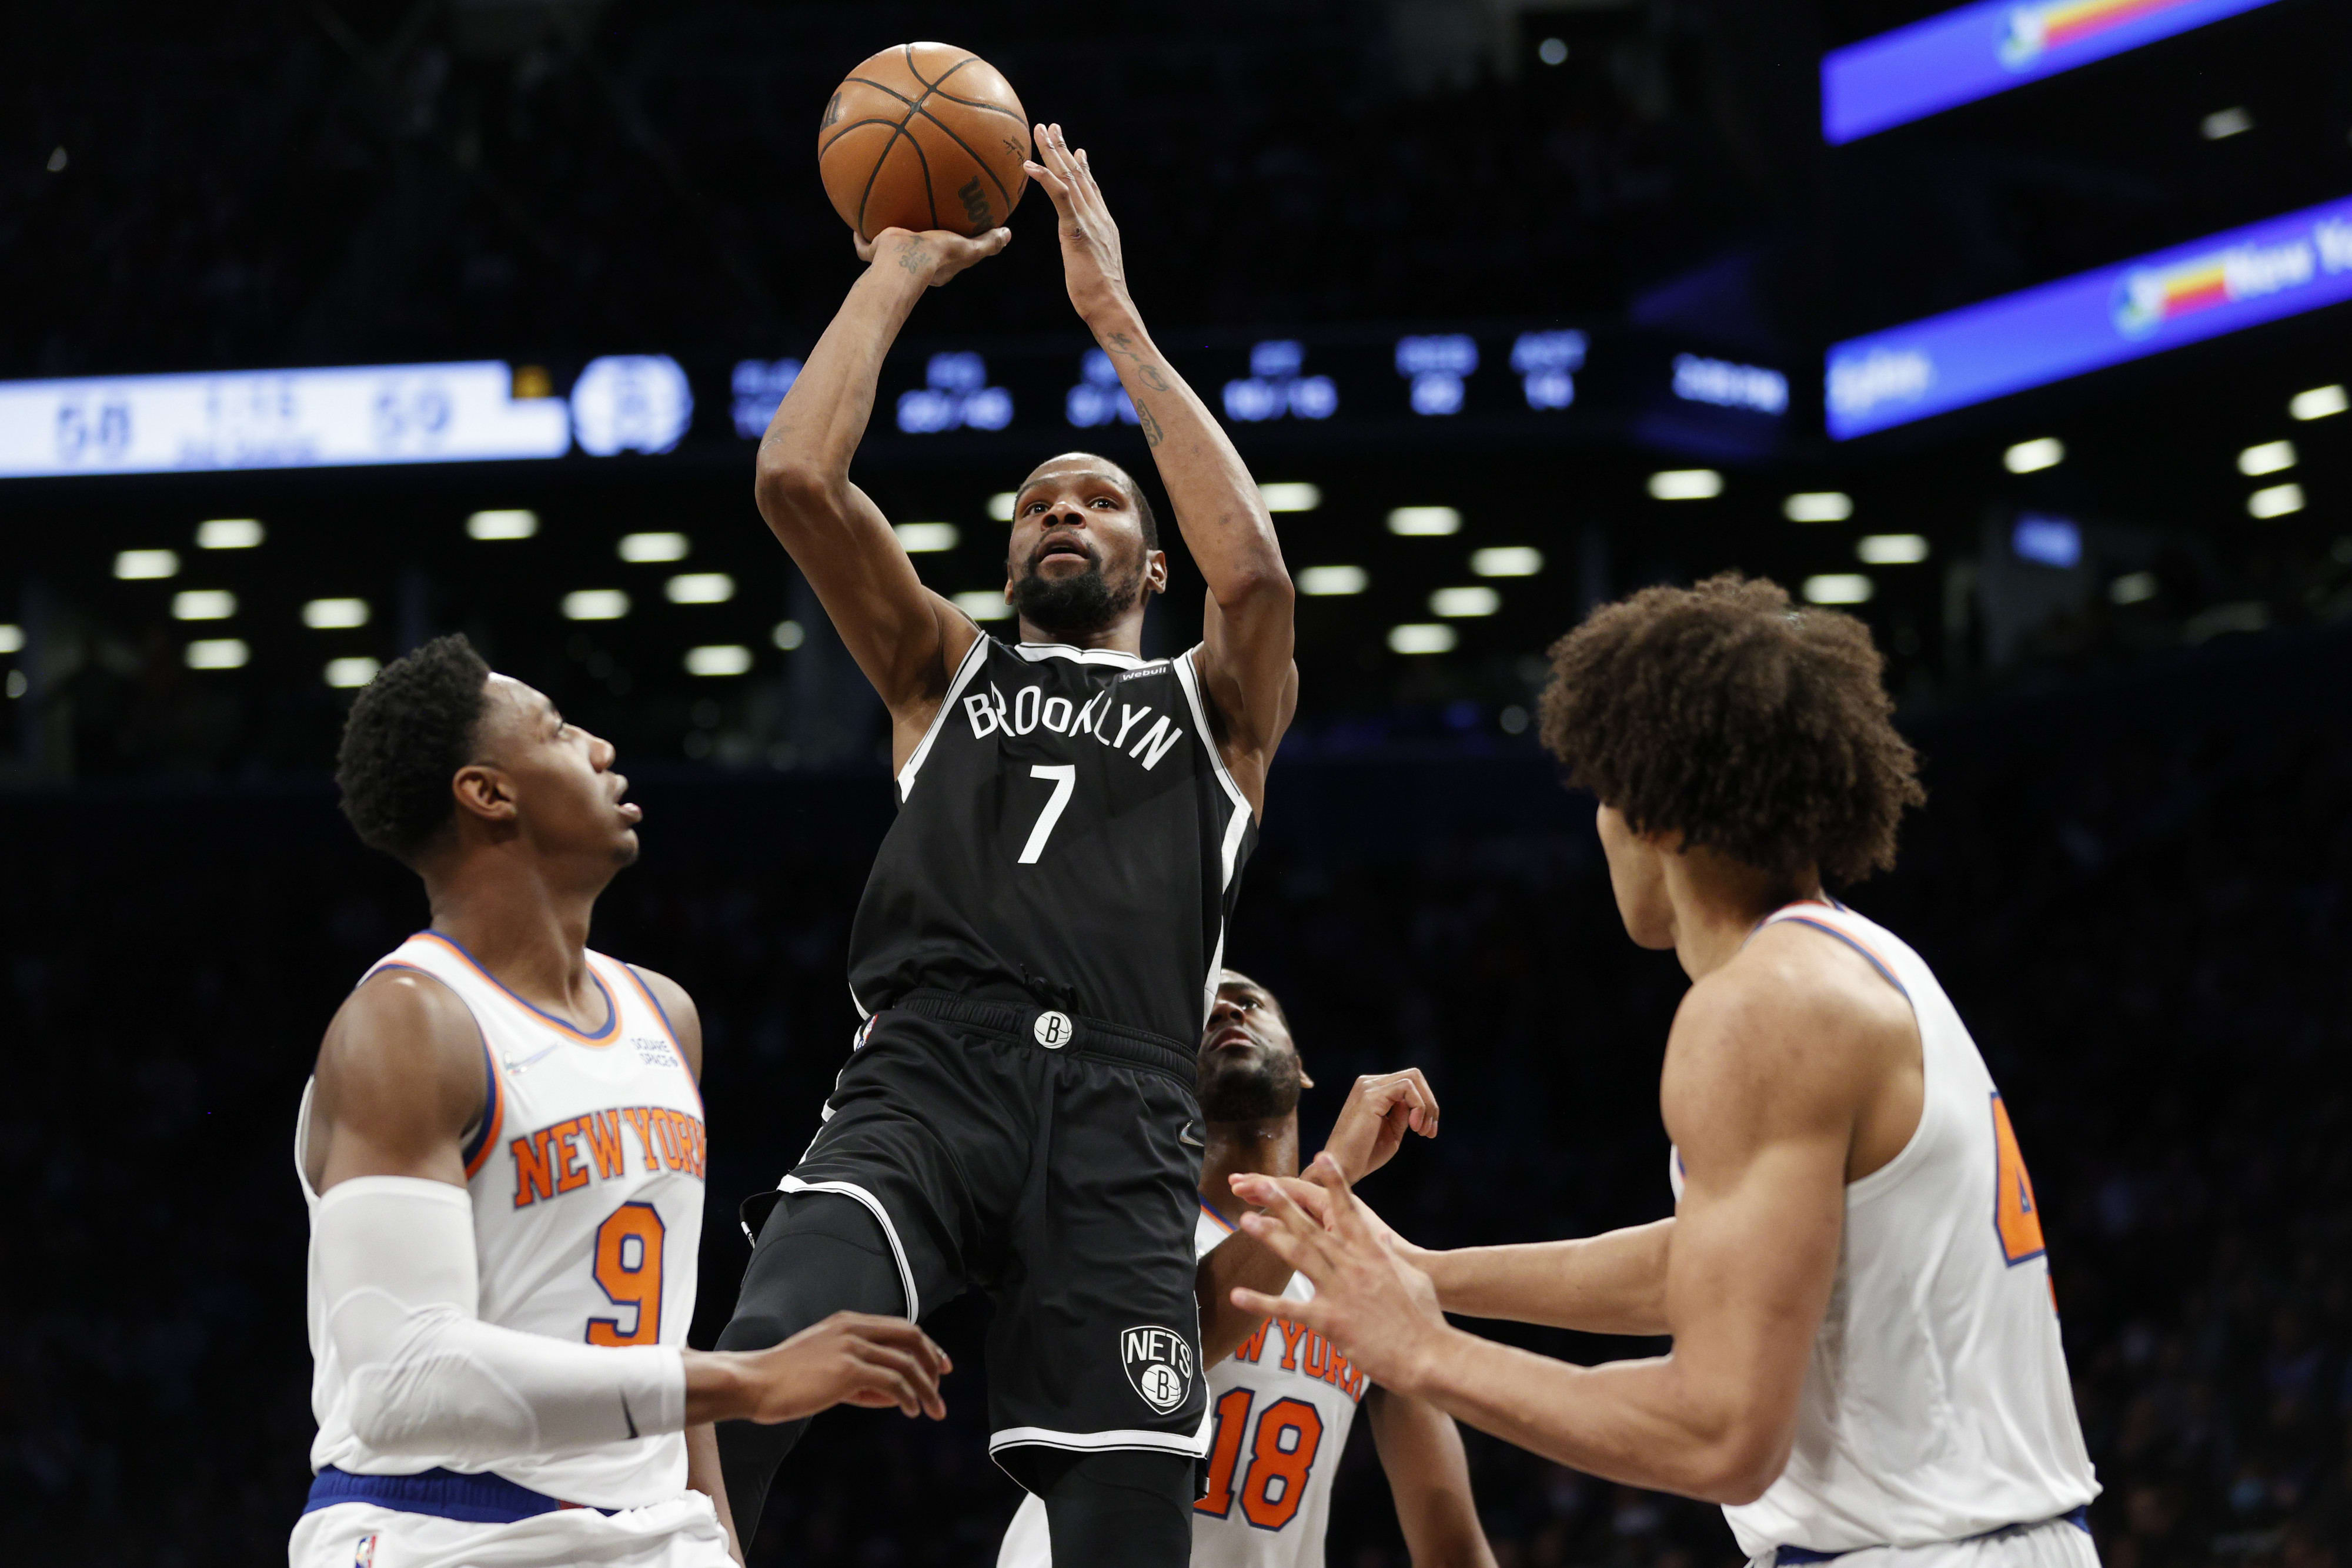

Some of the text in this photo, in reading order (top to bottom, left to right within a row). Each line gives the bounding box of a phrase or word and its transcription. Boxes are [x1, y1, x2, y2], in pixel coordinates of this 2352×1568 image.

[1122, 667, 1167, 681] Webull
[963, 681, 1183, 771] BROOKLYN
[1017, 764, 1076, 864] 7
[1045, 1015, 1061, 1044] B
[509, 1109, 625, 1210] NEW
[585, 1200, 666, 1348] 9
[1127, 1330, 1191, 1379] NETS
[1157, 1370, 1169, 1400] B
[1194, 1386, 1324, 1532] 18
